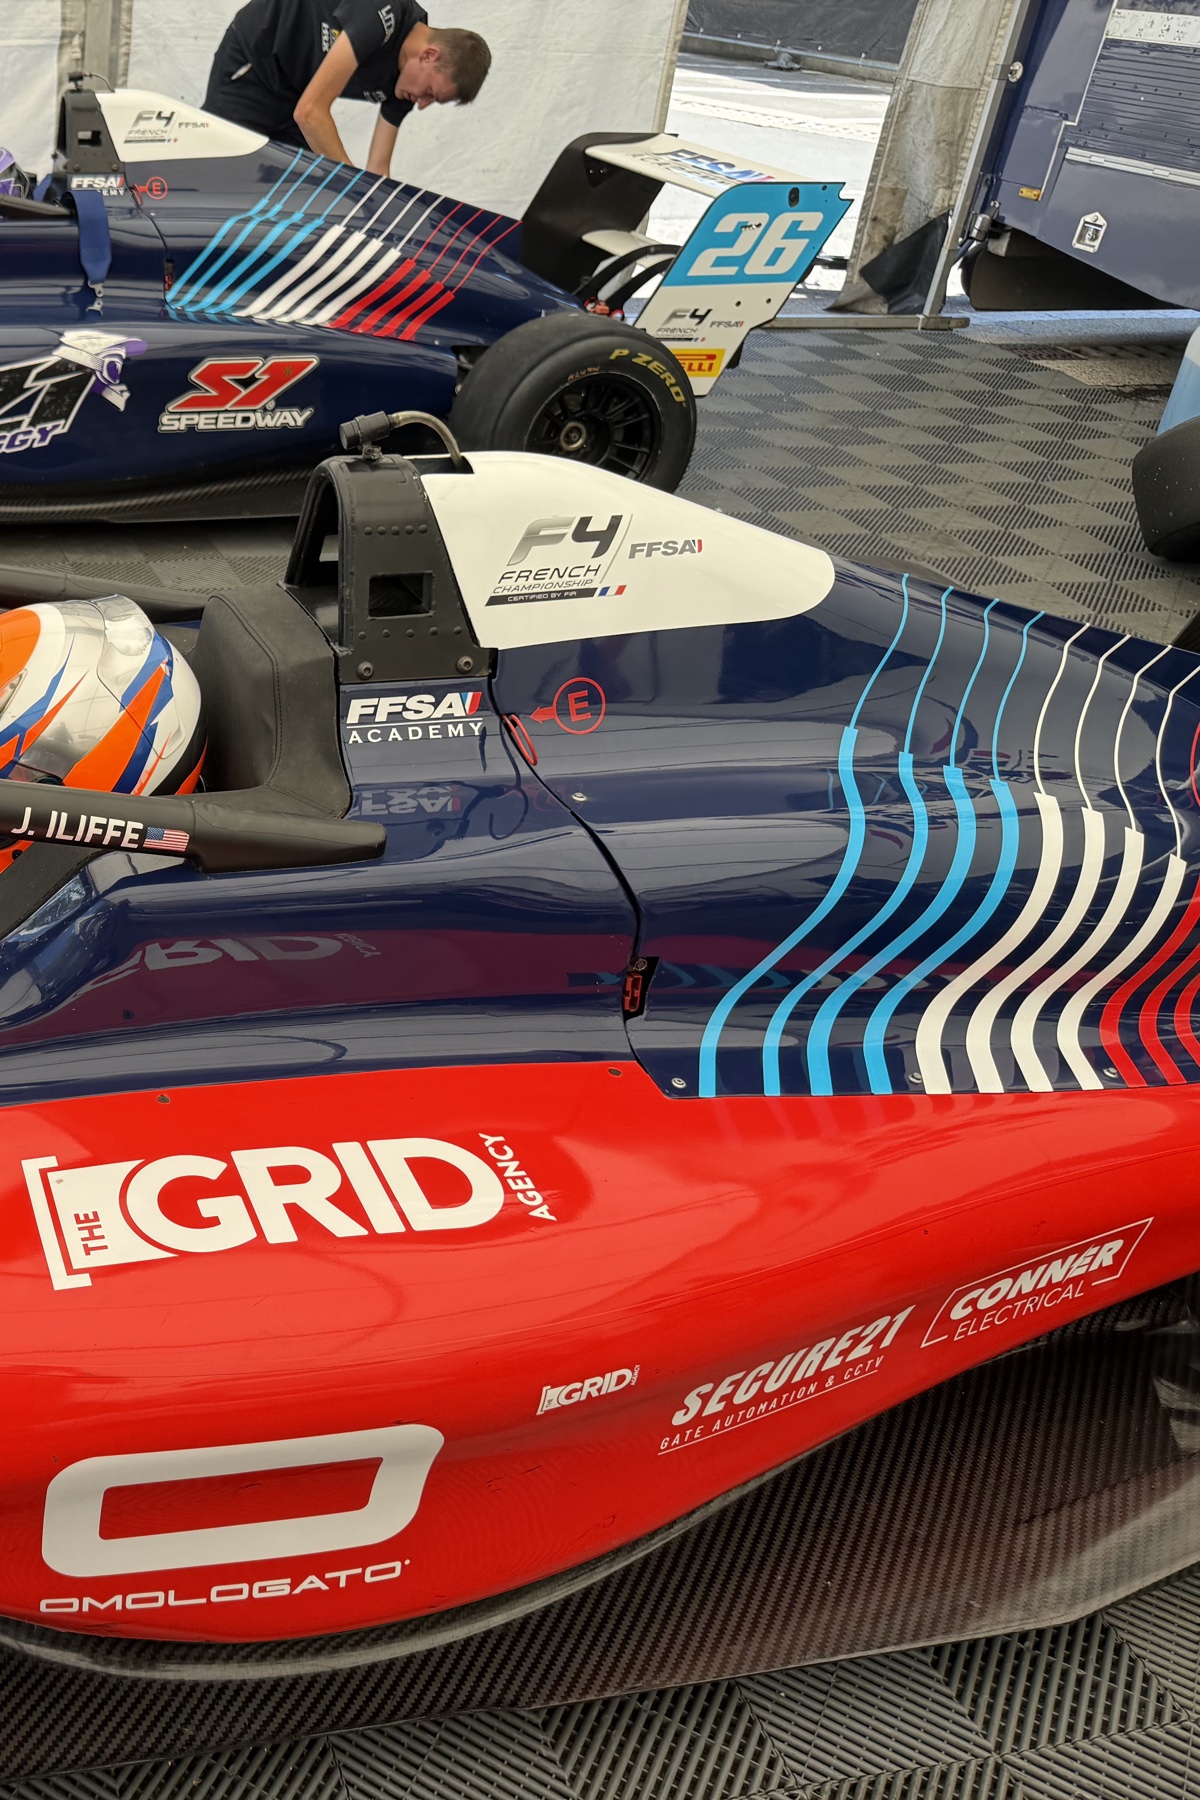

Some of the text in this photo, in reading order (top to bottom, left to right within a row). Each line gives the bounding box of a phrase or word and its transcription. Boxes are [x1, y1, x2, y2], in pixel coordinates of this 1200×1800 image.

[132, 110, 175, 128] F4
[71, 176, 124, 189] FFSA
[687, 212, 823, 276] 26
[662, 308, 713, 327] F4
[166, 354, 320, 412] S1
[631, 352, 686, 403] ZERO
[158, 408, 314, 433] SPEEDWAY
[507, 515, 623, 566] F4
[628, 539, 702, 559] FFSA
[493, 579, 594, 594] CHAMPIONSHIP
[498, 564, 601, 584] FRENCH
[508, 593, 549, 601] CERTIFIED
[347, 692, 482, 724] FFSA
[568, 690, 591, 722] E
[348, 722, 483, 744] ACADEMY
[11, 807, 144, 848] J. ILIFFE
[74, 1132, 557, 1256] THE GRID AGENCY
[950, 1239, 1124, 1320] CONNER
[953, 1280, 1084, 1341] ELECTRICAL
[671, 1304, 916, 1426] SECURE21
[558, 1368, 632, 1405] GRID
[660, 1355, 884, 1449] GATE AUTOMATION & CCTV
[40, 1560, 402, 1613] OMOLOGATO
